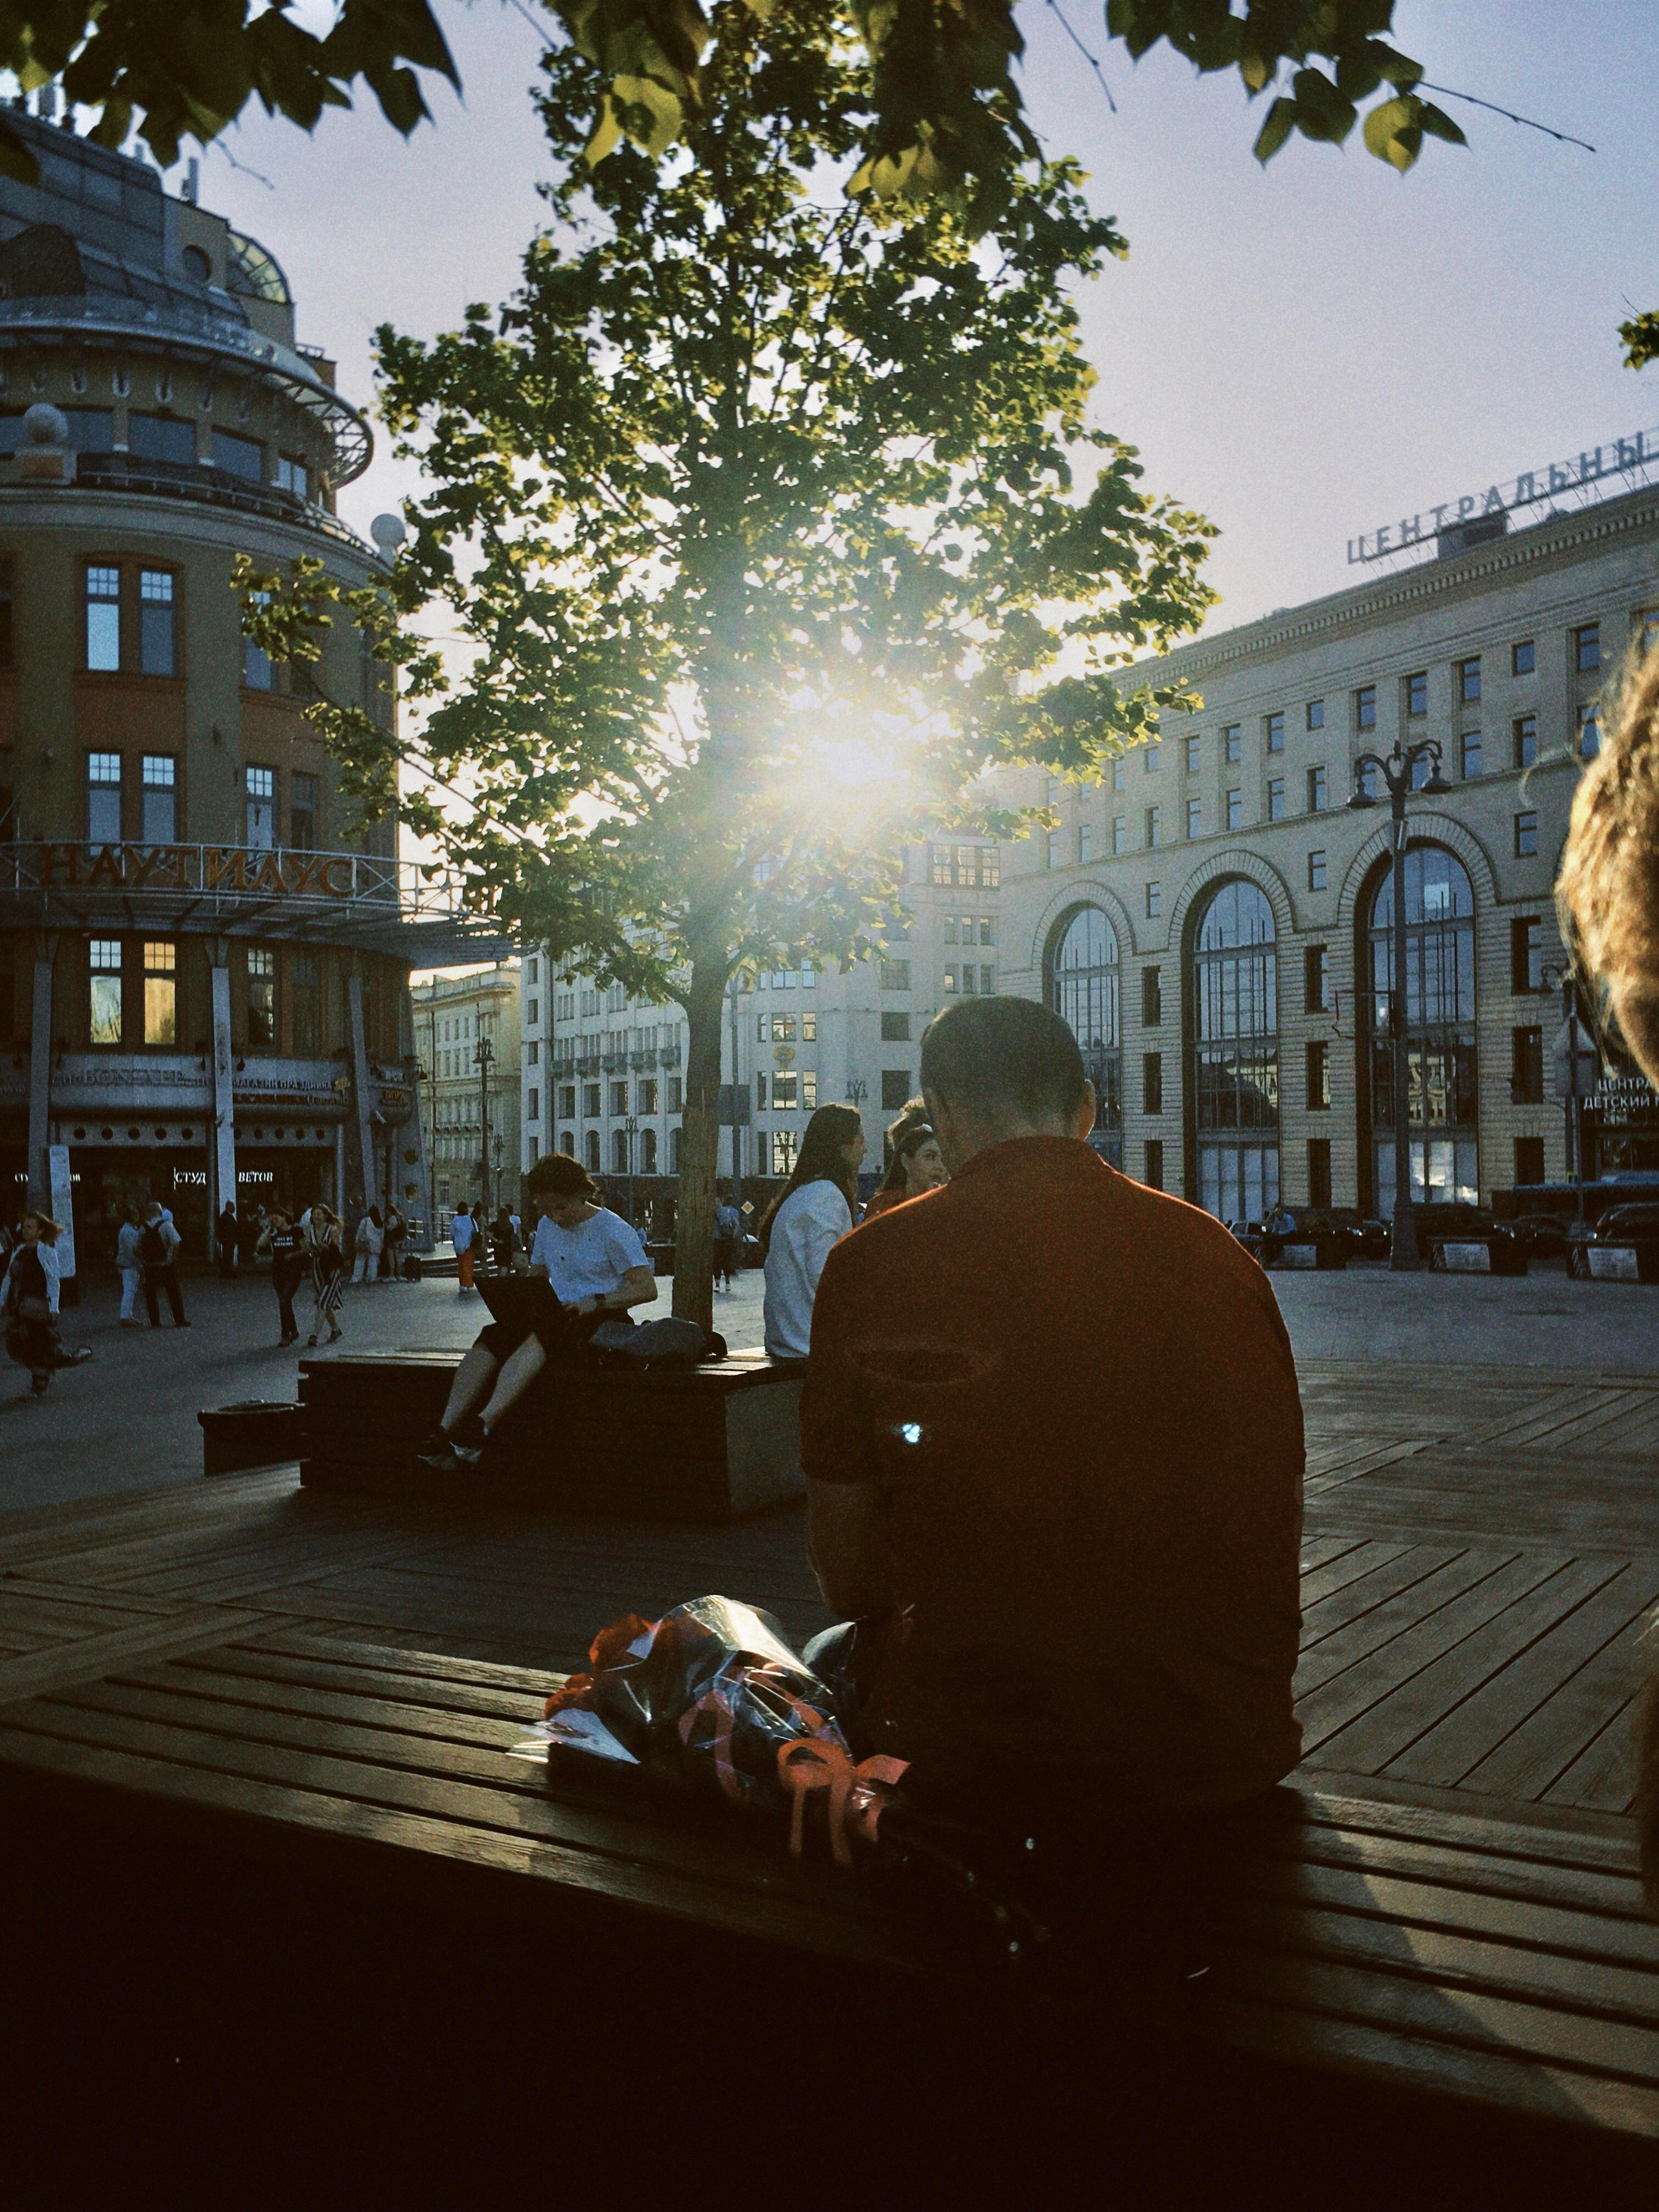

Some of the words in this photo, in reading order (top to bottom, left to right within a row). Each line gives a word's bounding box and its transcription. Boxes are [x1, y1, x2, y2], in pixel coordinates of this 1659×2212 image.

[1347, 430, 1644, 564] ЦЕНТРАЛЬНЫ
[41, 845, 355, 896] НАУТИЛУС
[1598, 1077, 1653, 1092] ЦЕНТРА
[1583, 1093, 1651, 1110] ДЕТСКИЙ
[176, 1171, 206, 1185] СТУД
[238, 1171, 273, 1183] ВЕТОВ
